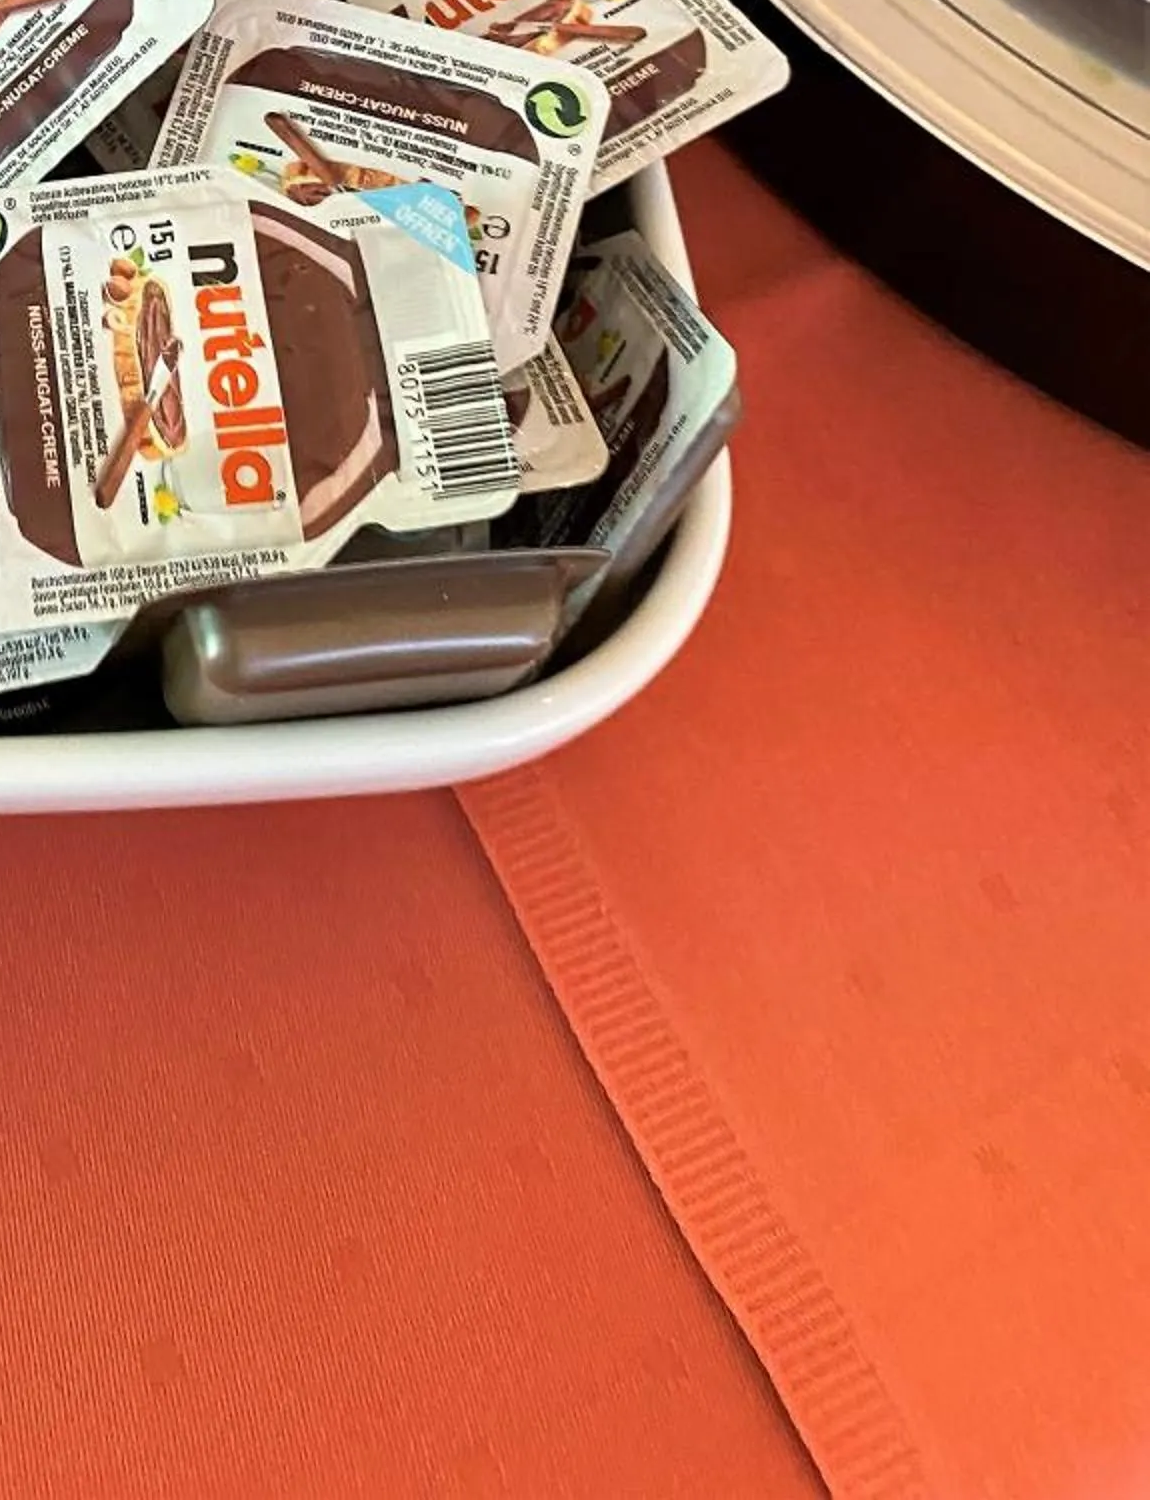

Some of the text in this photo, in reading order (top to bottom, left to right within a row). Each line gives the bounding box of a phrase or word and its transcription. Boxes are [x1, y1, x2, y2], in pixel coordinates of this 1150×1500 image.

[296, 79, 469, 134] NUSS-NUGAT-CREME
[609, 63, 660, 98] CREME
[475, 252, 499, 275] 15
[25, 304, 62, 488] NUSS-NUGAT-CREME
[187, 241, 288, 508] nutella
[397, 362, 434, 493] 8075 1151
